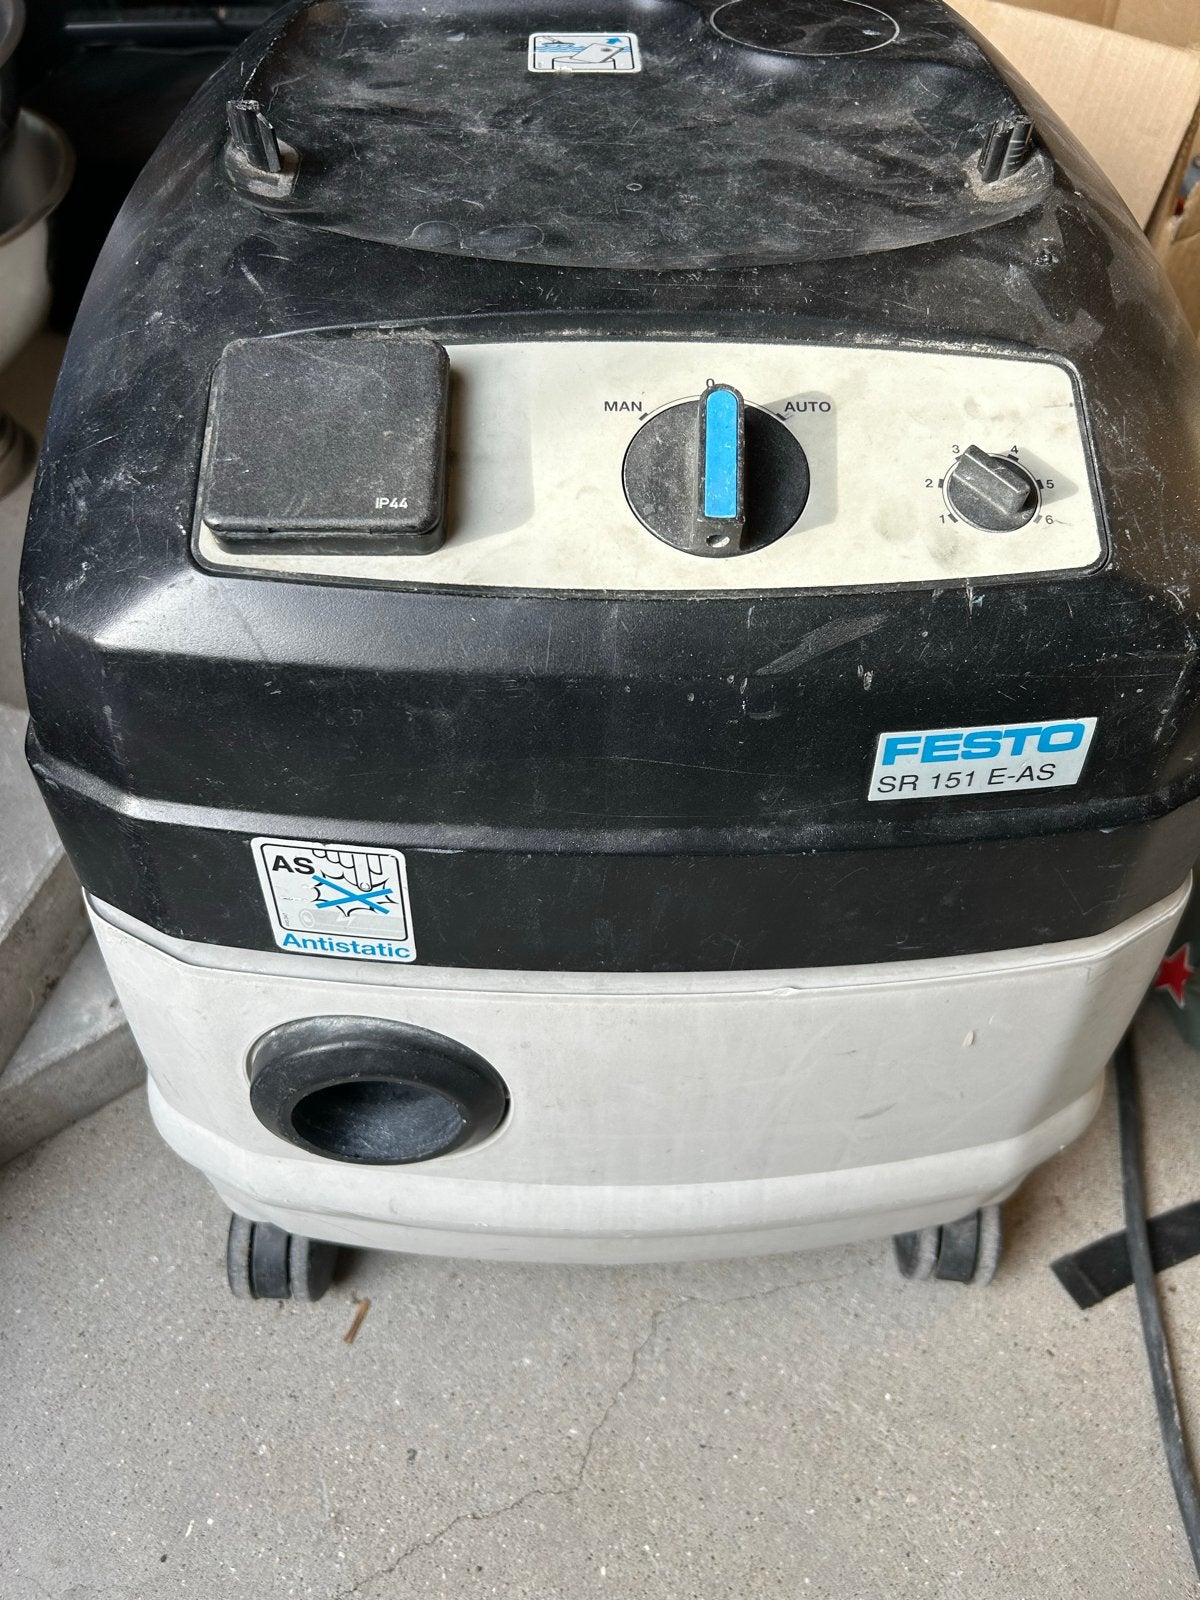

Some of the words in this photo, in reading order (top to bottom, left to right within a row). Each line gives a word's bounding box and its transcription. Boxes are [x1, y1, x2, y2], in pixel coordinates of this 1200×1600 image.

[604, 401, 643, 412] MAN
[784, 401, 832, 413] AUTO
[952, 444, 960, 454] 3
[1010, 445, 1019, 454] 4
[925, 478, 934, 488] 2
[1046, 480, 1055, 489] 5
[375, 497, 409, 509] IP44
[940, 514, 946, 524] 1
[1045, 515, 1054, 525] 6
[881, 722, 1086, 766] FESTO
[877, 774, 919, 793] SR
[931, 770, 976, 790] 151
[987, 763, 1057, 786] E-AS
[272, 855, 316, 875] AS
[282, 933, 411, 959] Antistatic
